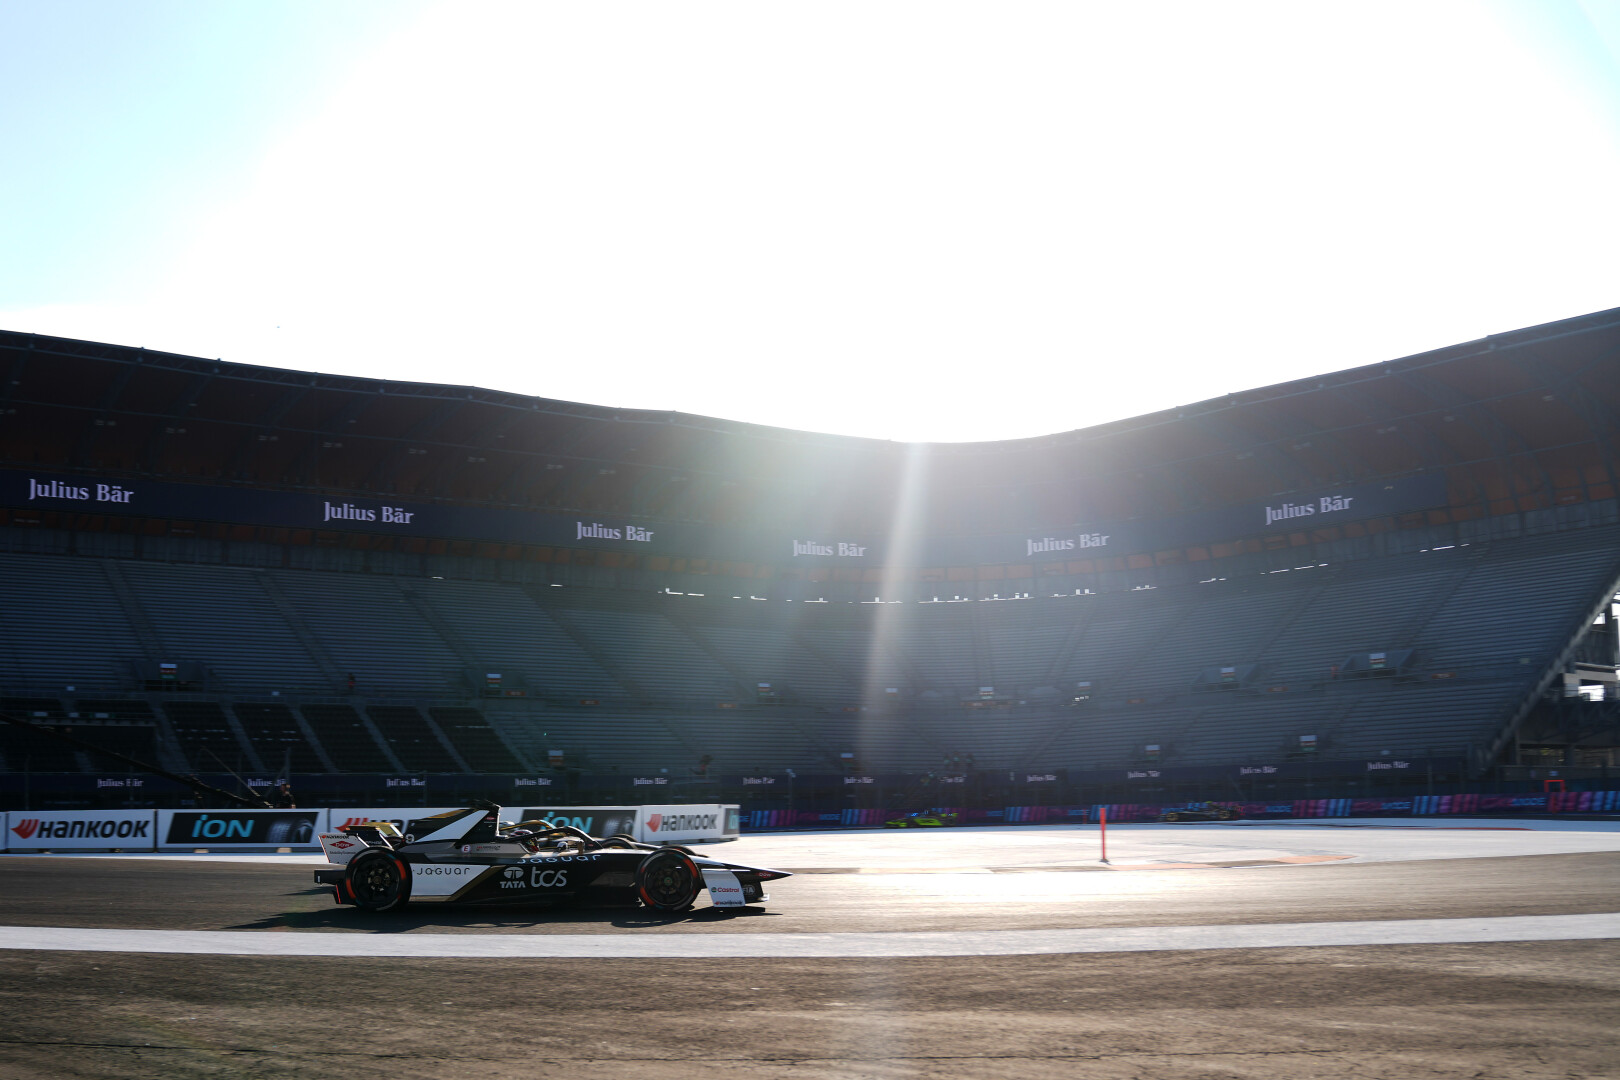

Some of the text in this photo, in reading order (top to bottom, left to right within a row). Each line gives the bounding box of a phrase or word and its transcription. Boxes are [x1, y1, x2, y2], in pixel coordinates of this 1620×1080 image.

[28, 478, 135, 503] Julius Bär
[323, 501, 414, 524] Julius Bär
[1265, 495, 1354, 526] Julius Bär
[576, 521, 655, 542] Julius Bär
[792, 539, 868, 557] Julius Bär
[1026, 533, 1110, 557] Julius Bär
[405, 833, 415, 844] 9
[499, 880, 526, 889] TATA
[530, 866, 568, 888] tcs
